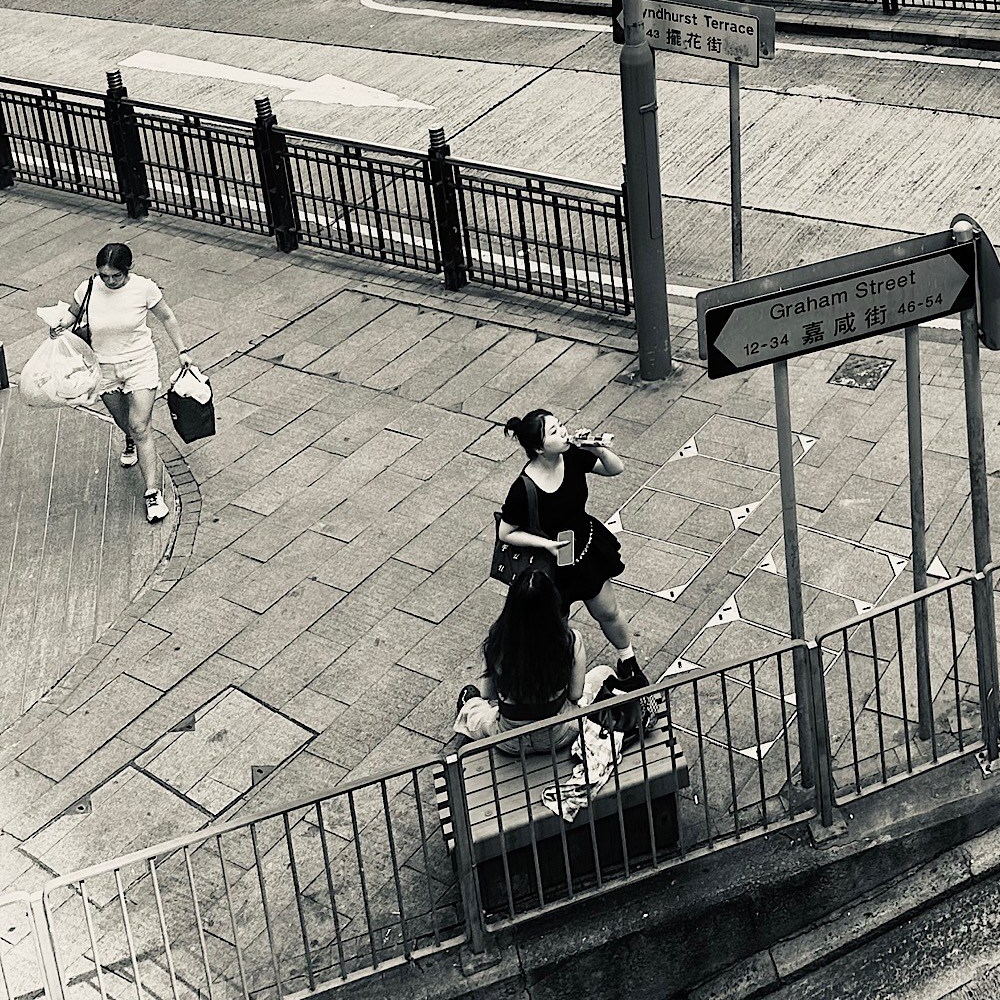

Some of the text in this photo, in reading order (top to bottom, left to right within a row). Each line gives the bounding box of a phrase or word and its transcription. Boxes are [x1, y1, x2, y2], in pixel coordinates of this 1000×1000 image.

[666, 29, 722, 53] 擺花街
[704, 15, 754, 35] Terrace
[769, 269, 917, 320] Graham Street
[744, 292, 943, 356] 12-34 嘉咸街 46-54
